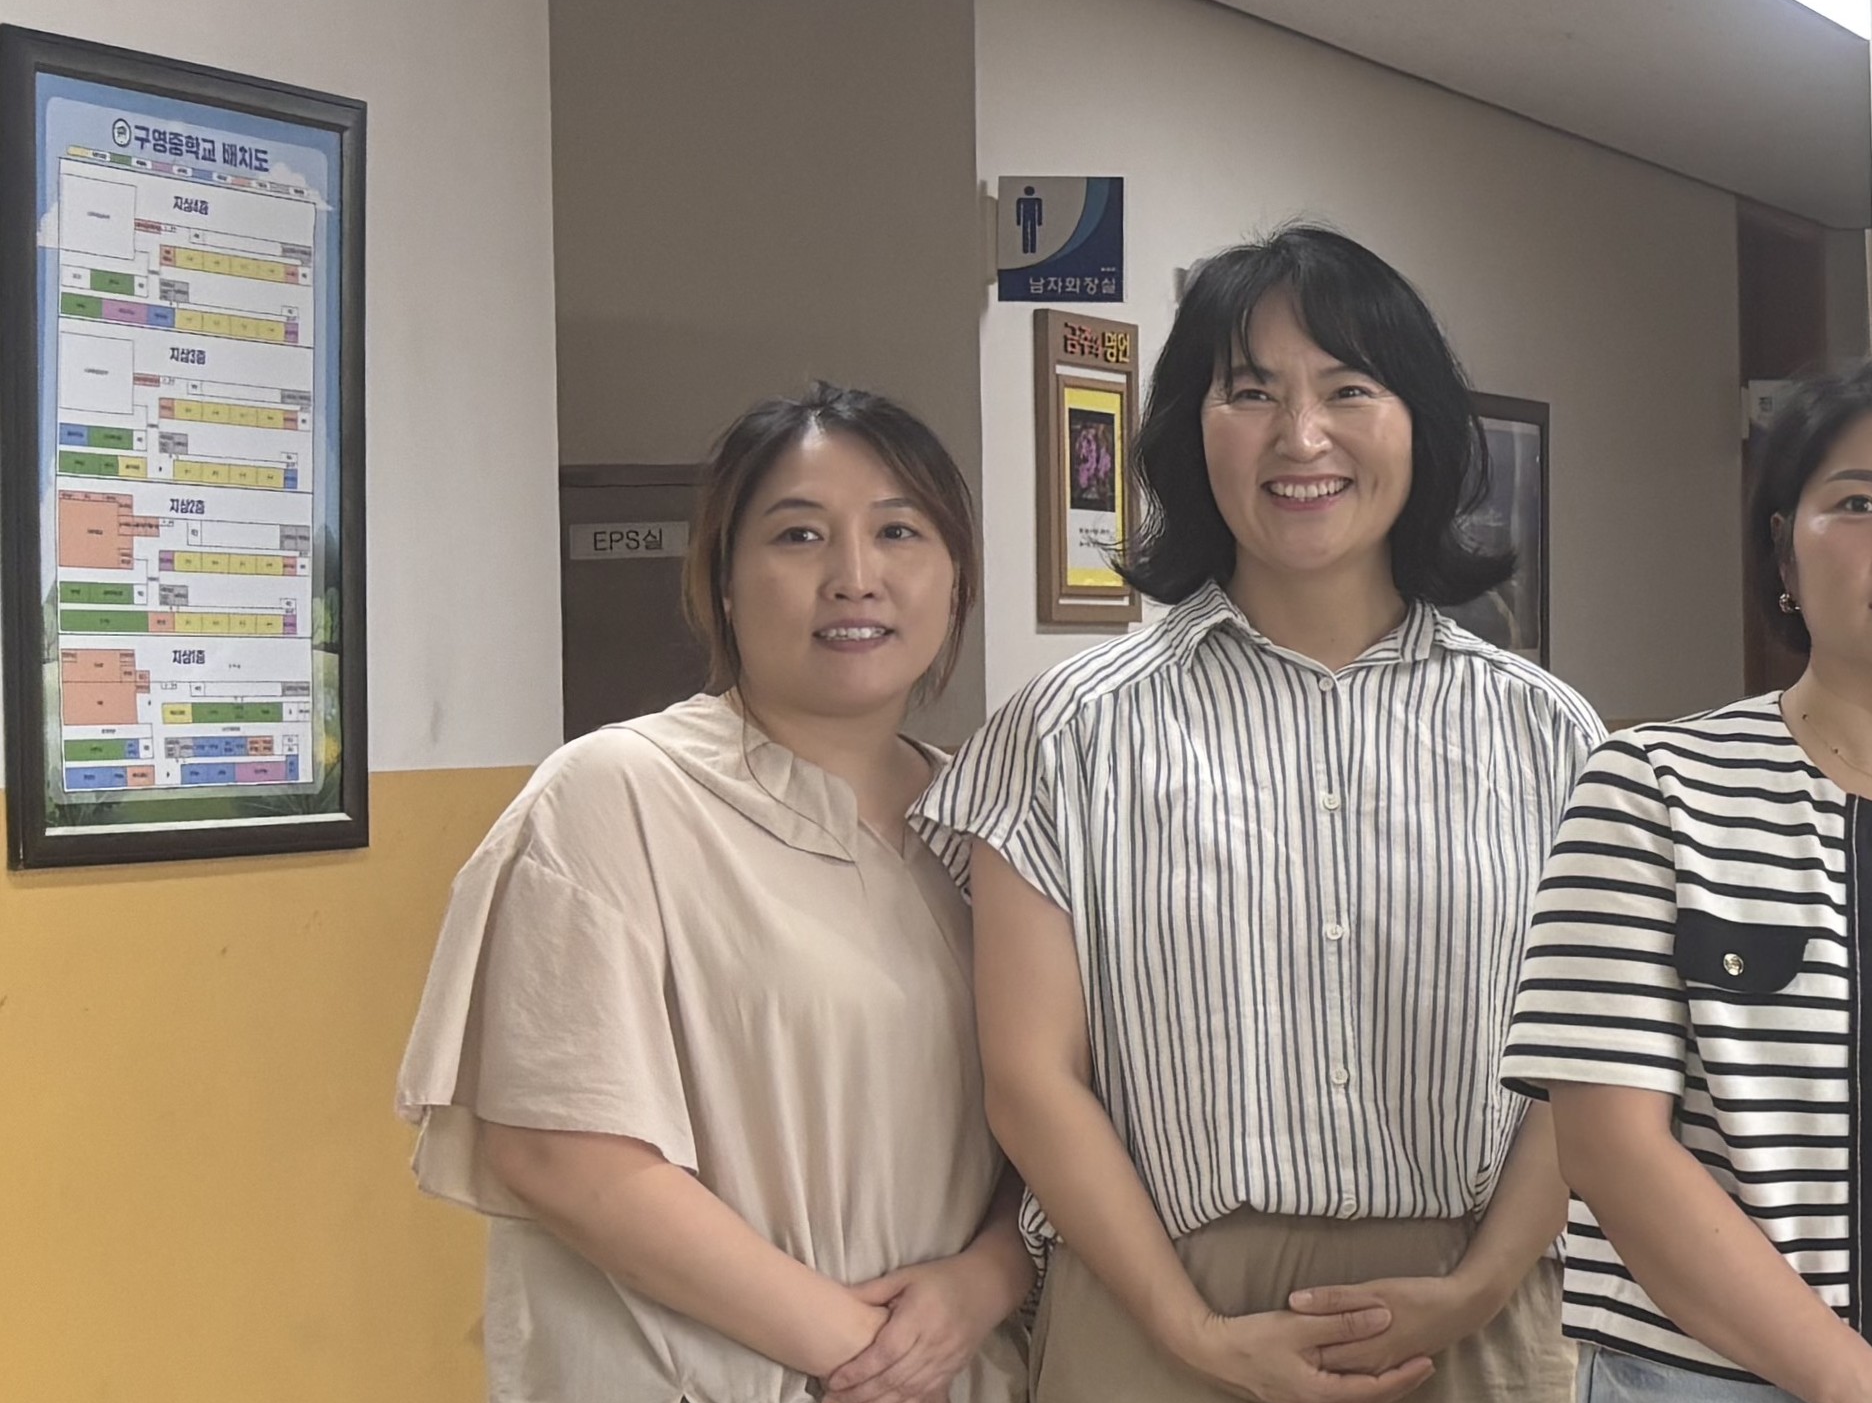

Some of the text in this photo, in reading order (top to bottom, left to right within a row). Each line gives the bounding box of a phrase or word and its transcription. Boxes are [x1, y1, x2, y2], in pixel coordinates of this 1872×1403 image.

[134, 124, 270, 173] 구영중학교 배치도
[1029, 277, 1117, 295] 남자화장실
[593, 528, 664, 552] EPS실
